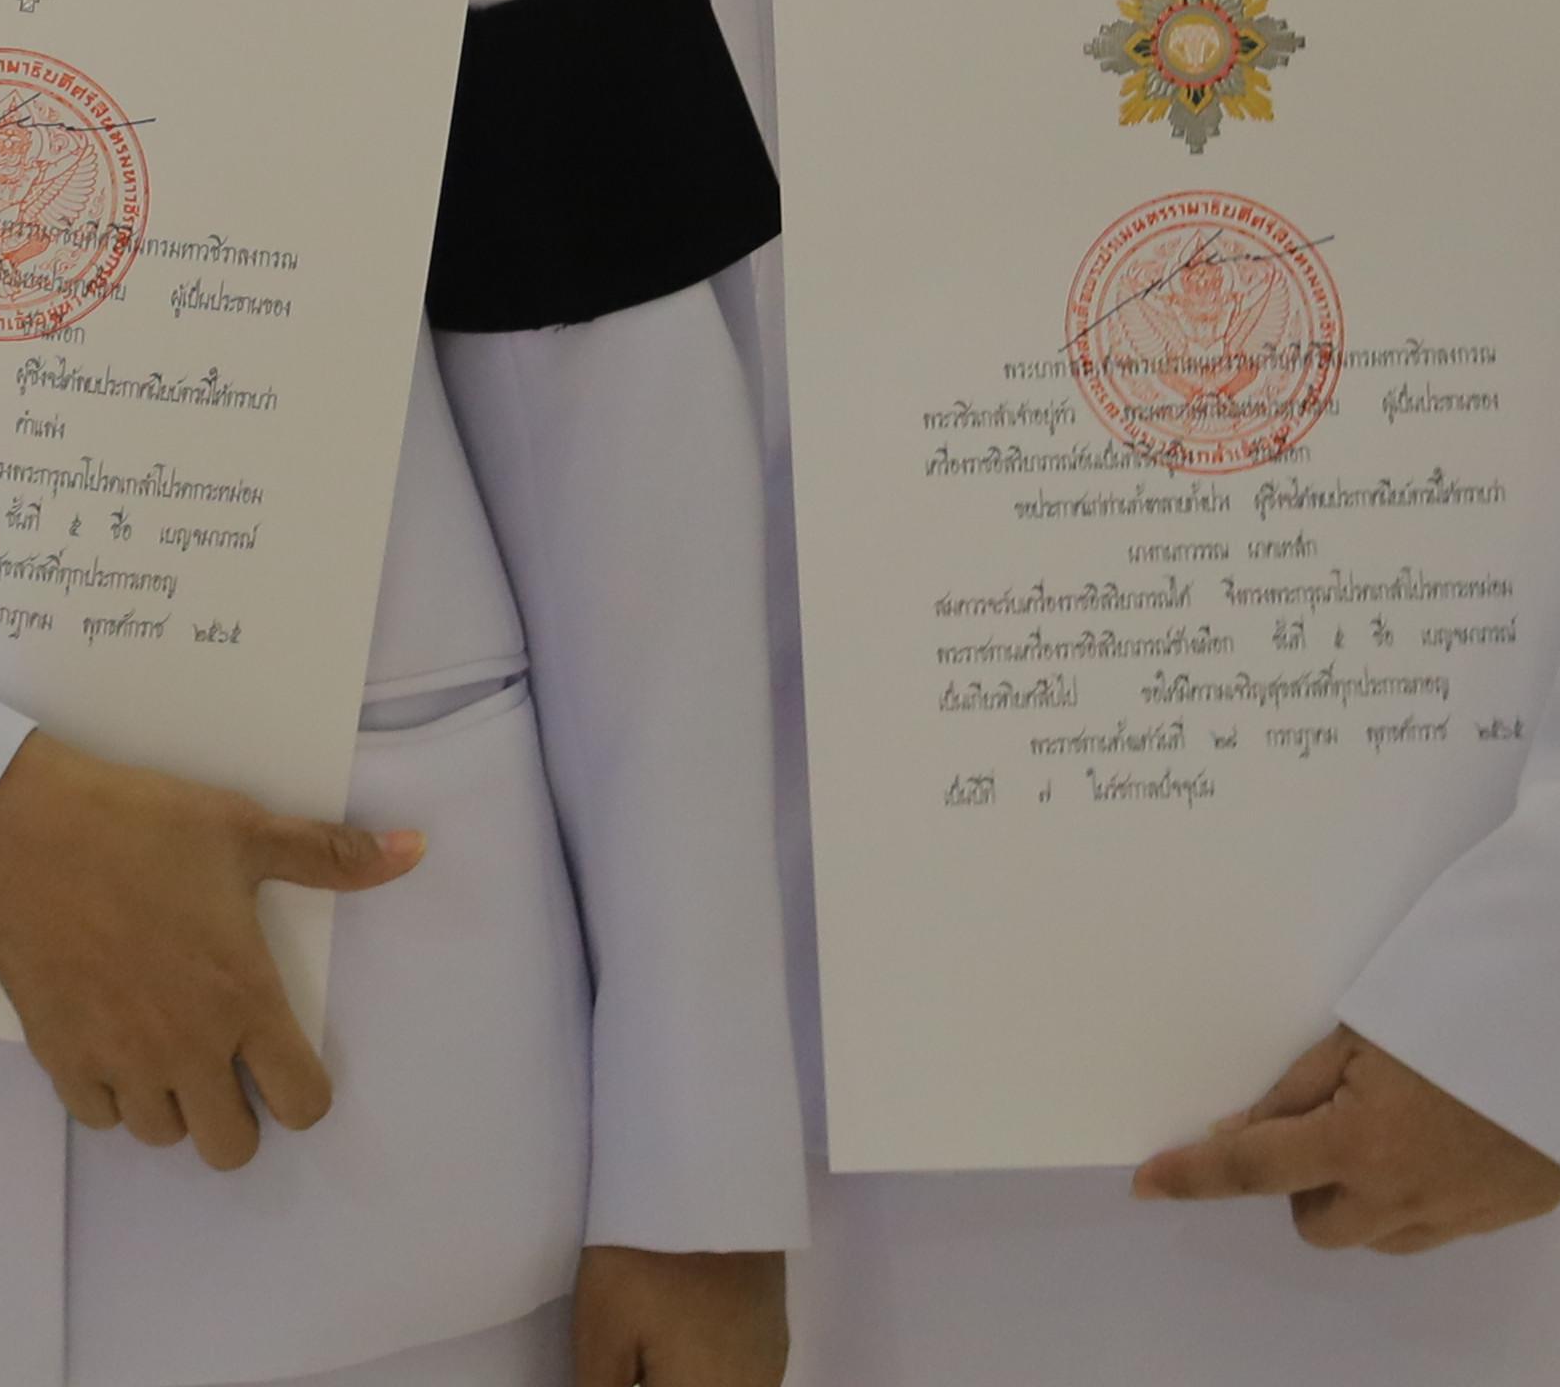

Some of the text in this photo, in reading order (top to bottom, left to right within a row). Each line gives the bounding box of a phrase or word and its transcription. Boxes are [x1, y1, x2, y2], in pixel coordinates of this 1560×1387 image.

[69, 513, 82, 537] ๕
[110, 506, 132, 541] ชื่อ
[193, 619, 241, 644] ๒๕๖๕
